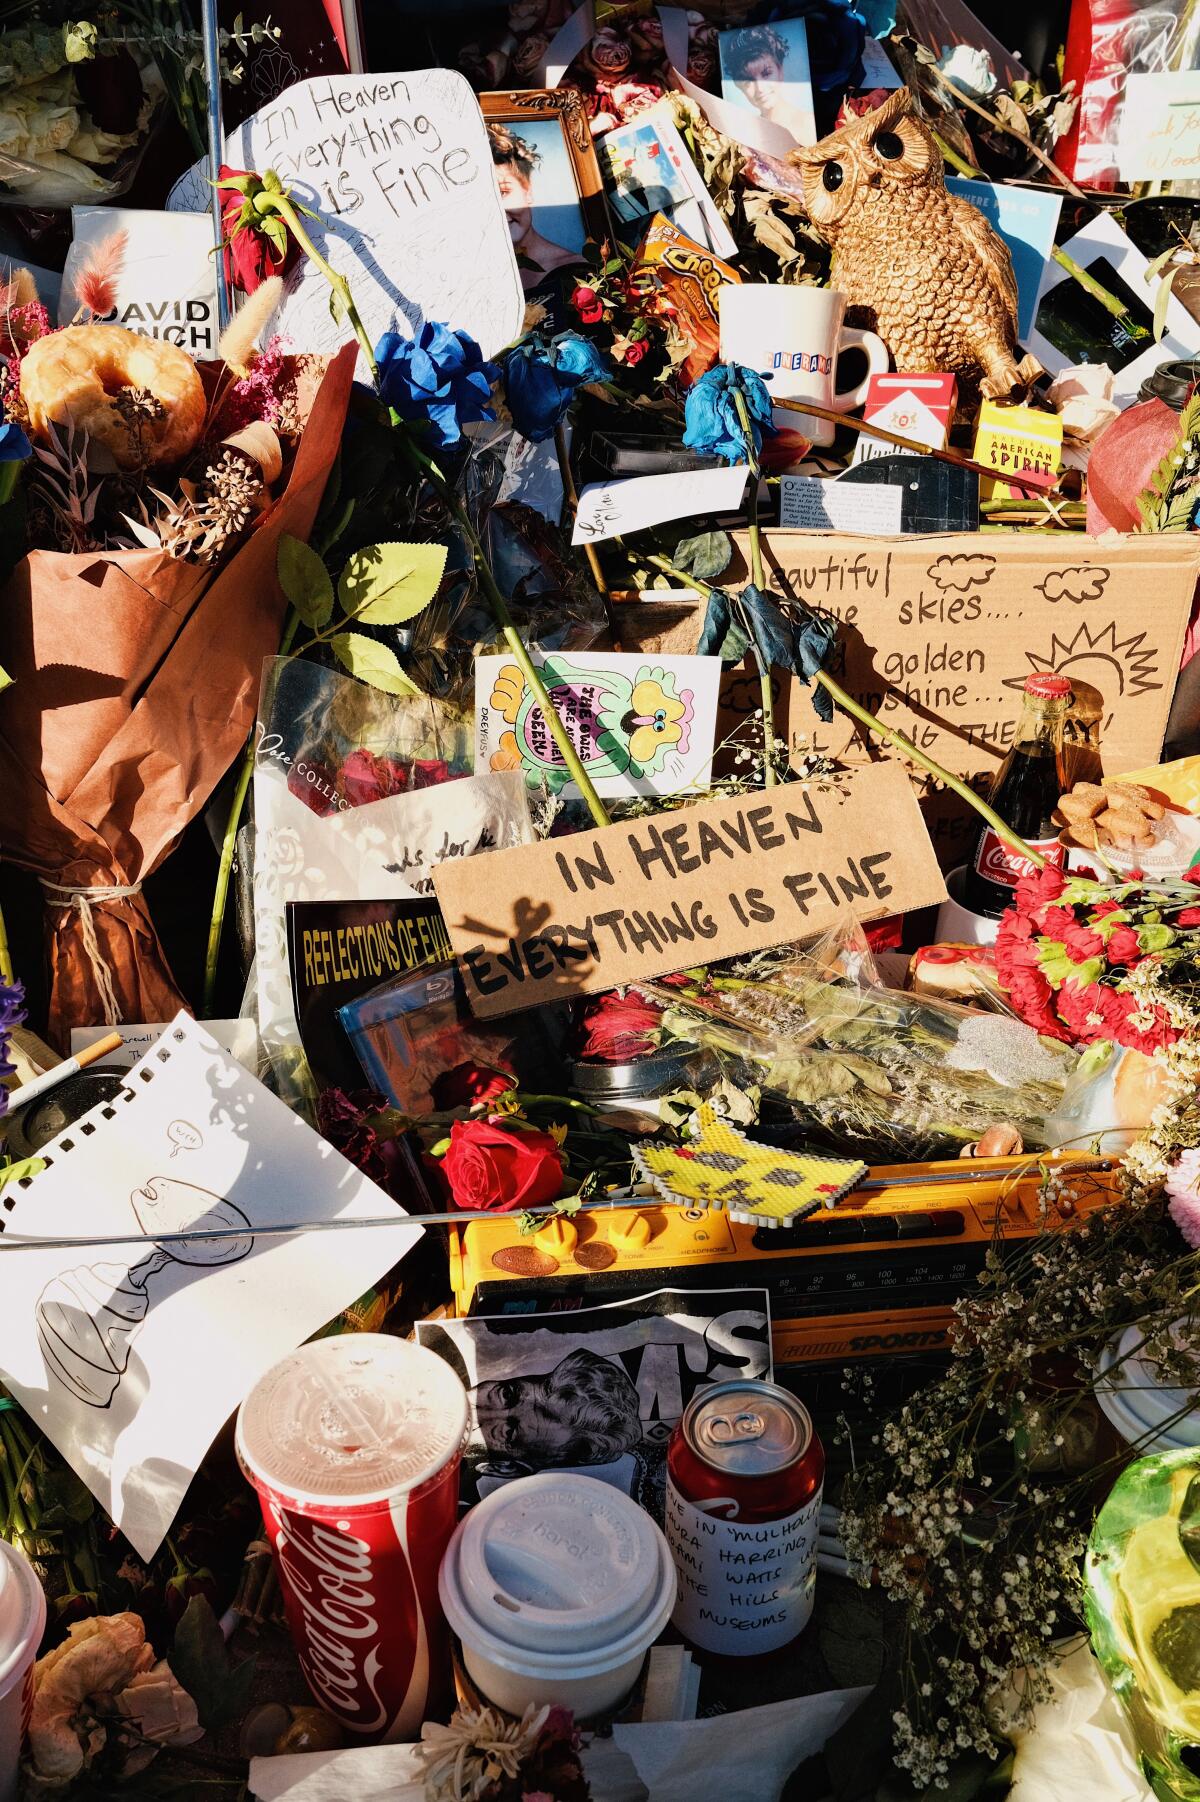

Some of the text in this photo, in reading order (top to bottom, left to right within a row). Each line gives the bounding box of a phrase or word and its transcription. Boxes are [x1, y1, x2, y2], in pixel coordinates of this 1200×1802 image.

[261, 78, 412, 151] In Heaven
[271, 113, 442, 182] Everything
[371, 147, 480, 218] Fine
[990, 450, 1052, 477] SPIRIT
[991, 441, 1053, 463] AMERICAN
[884, 642, 985, 684] golden
[565, 693, 578, 724] ARE
[578, 686, 596, 720] THE
[479, 706, 490, 754] DREYFUS
[578, 722, 593, 761] OWLS
[959, 719, 1016, 746] THE
[555, 790, 824, 893] IN HEAVEN
[462, 851, 893, 997] EVERYTHING IS FINE
[303, 919, 401, 987] REFLECTIONS
[398, 918, 419, 969] OF
[878, 1270, 892, 1279] 100
[914, 1267, 928, 1275] 104
[849, 1330, 946, 1351] SPORTS
[726, 1567, 783, 1585] WATTS
[270, 1503, 386, 1734] Coca-Cola
[700, 1607, 787, 1631] MUSEUMS
